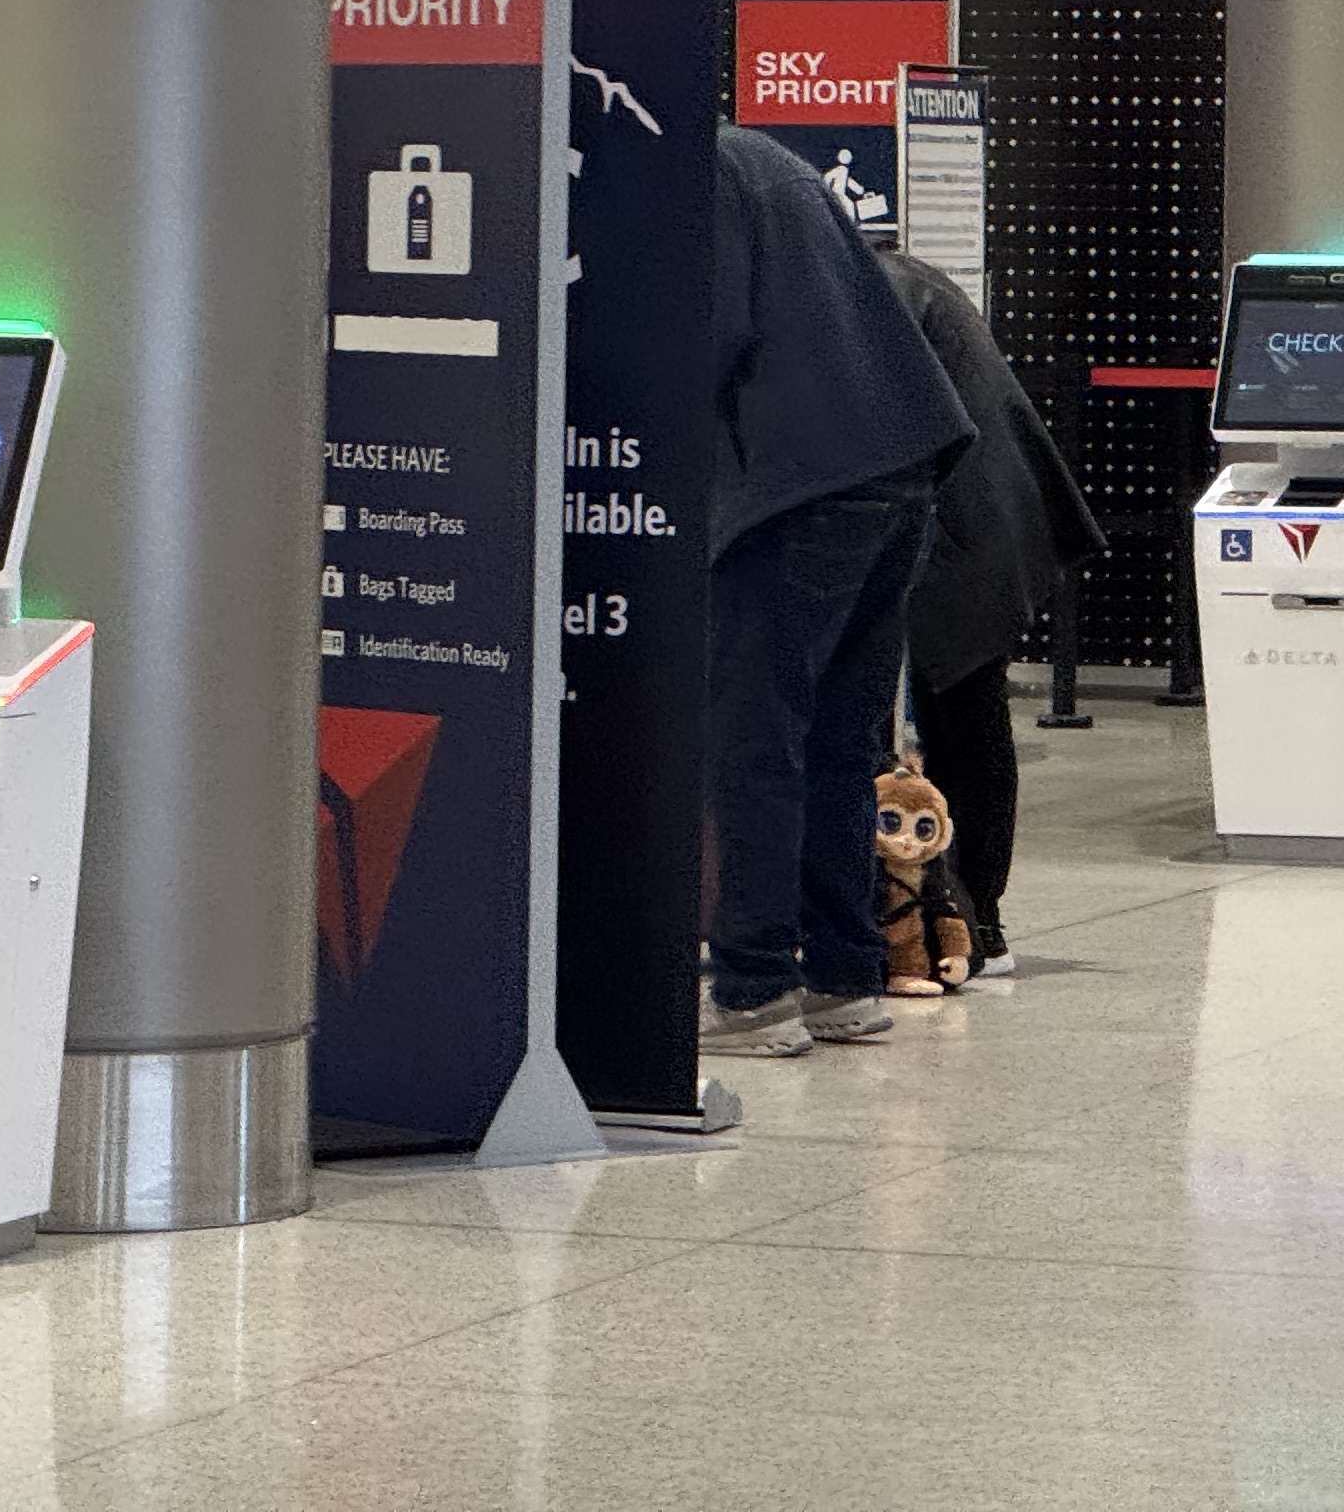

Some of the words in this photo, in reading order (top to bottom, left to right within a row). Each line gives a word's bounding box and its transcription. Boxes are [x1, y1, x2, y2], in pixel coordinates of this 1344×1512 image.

[756, 51, 825, 77] SKY
[756, 79, 895, 106] PRIORIT
[906, 87, 980, 120] ATTENTION
[1268, 332, 1344, 353] CHECK
[323, 442, 388, 471] PLEASE
[391, 445, 451, 474] HAVE:
[609, 425, 641, 469] is
[359, 506, 426, 538] Boarding
[429, 511, 467, 535] Pass
[359, 573, 395, 602] Bags
[397, 576, 456, 606] Tagged
[604, 593, 629, 637] 3
[359, 634, 459, 664] Identification
[462, 642, 511, 674] Ready
[1267, 648, 1338, 667] DELTA
